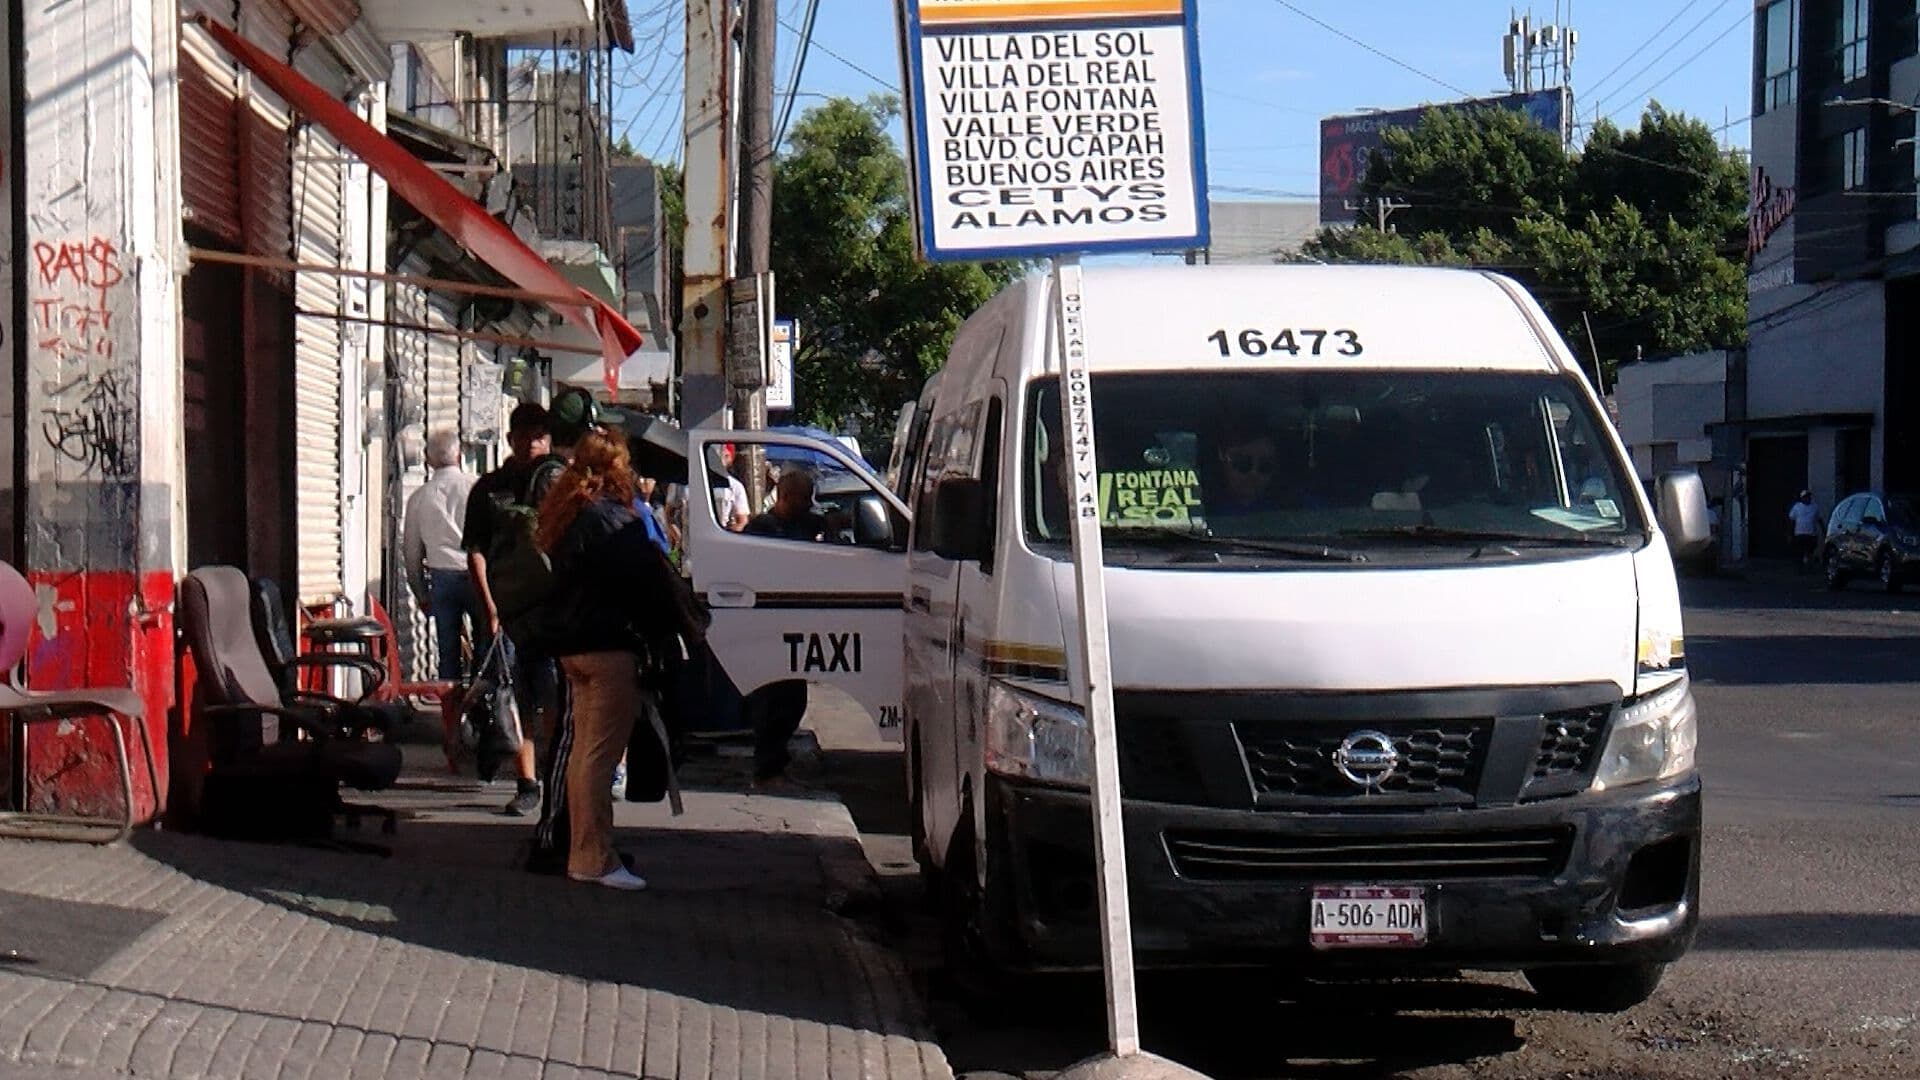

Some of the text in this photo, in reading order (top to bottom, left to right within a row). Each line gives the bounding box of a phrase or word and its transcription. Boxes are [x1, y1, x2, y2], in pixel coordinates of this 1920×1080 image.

[936, 31, 1154, 62] VILLA DEL SOL
[938, 59, 1157, 89] VILLA DEL REAL
[940, 87, 1158, 115] VILLA FONTANA
[942, 112, 1162, 138] VALLE VERDE
[1025, 134, 1164, 160] CUCAPAH
[947, 156, 1166, 186] BUENOS AIRES
[948, 183, 1167, 207] CETYS
[951, 204, 1168, 229] ALAMOS
[1207, 328, 1364, 358] 16473
[1078, 470, 1093, 483] Y
[1115, 470, 1199, 489] FONTANA
[1117, 486, 1202, 507] REAL
[783, 632, 862, 672] TAXI
[1314, 903, 1423, 929] A-506-ADW
